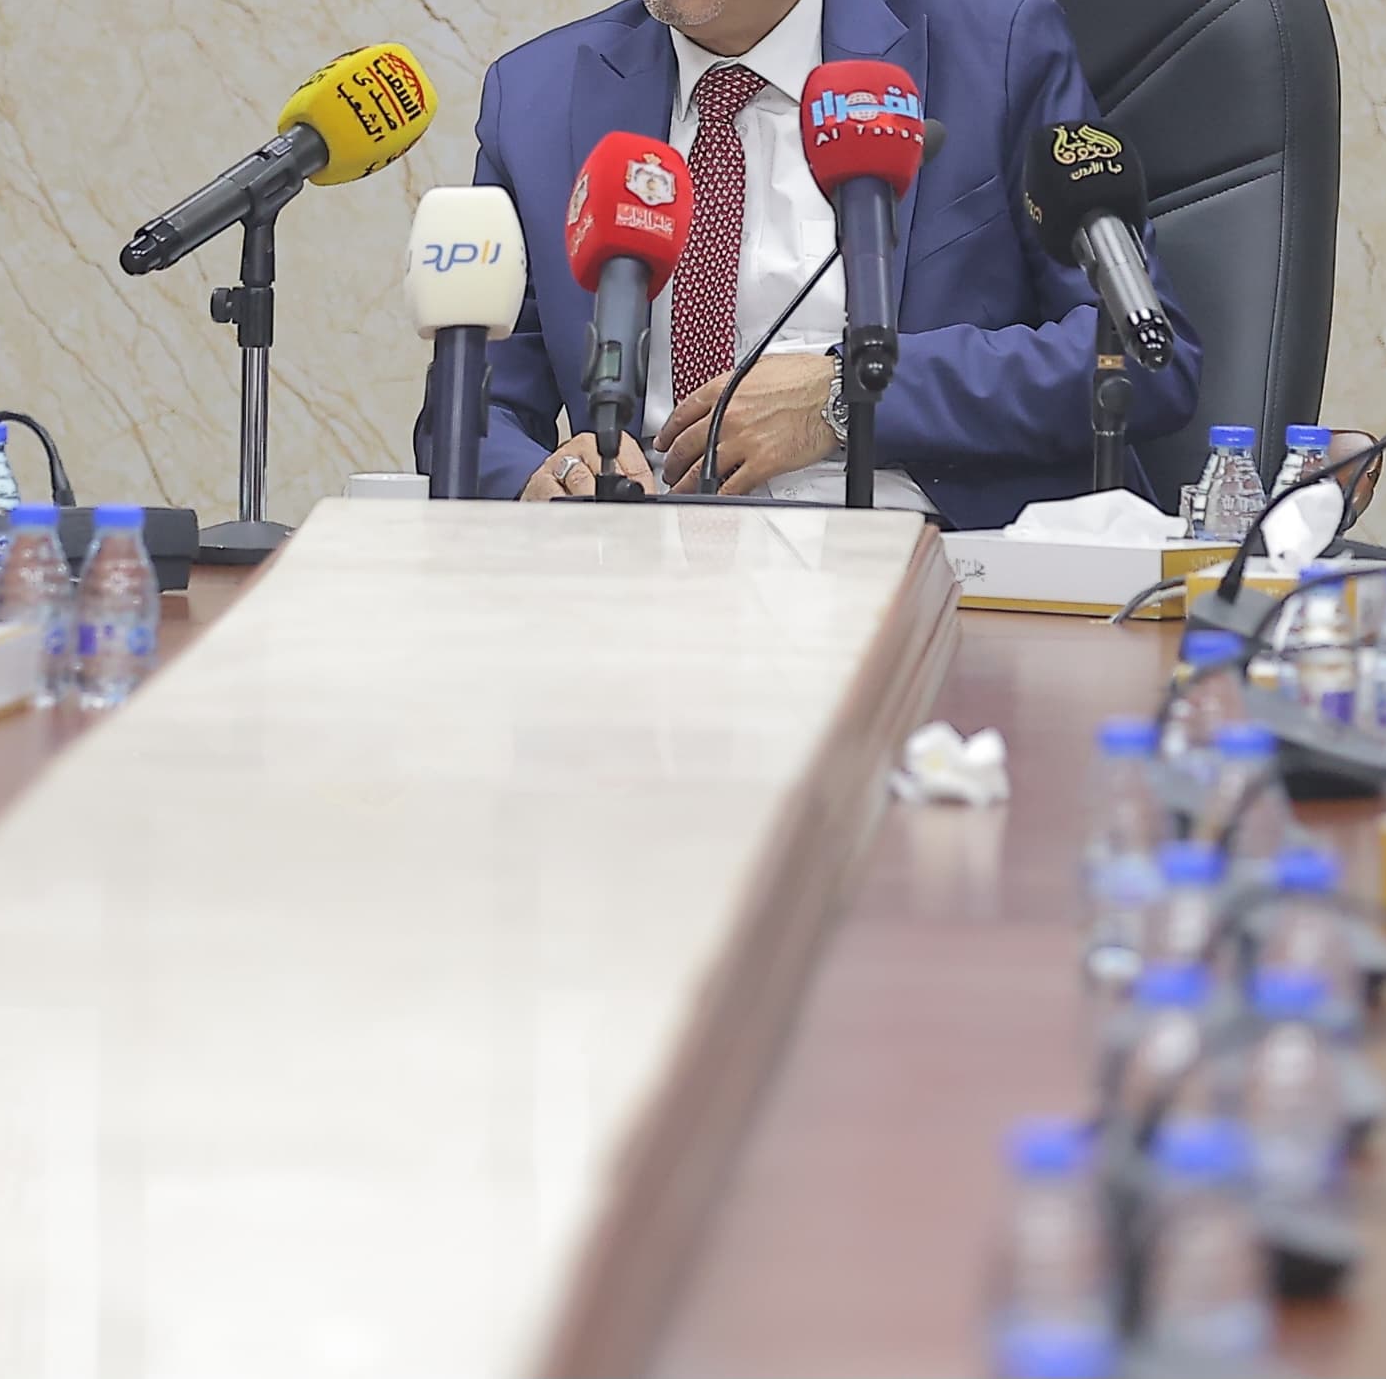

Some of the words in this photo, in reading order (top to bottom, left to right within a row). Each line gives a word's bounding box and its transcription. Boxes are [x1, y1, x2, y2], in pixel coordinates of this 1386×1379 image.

[336, 82, 386, 143] الشعب
[352, 72, 398, 131] صدى
[616, 205, 654, 230] النواب
